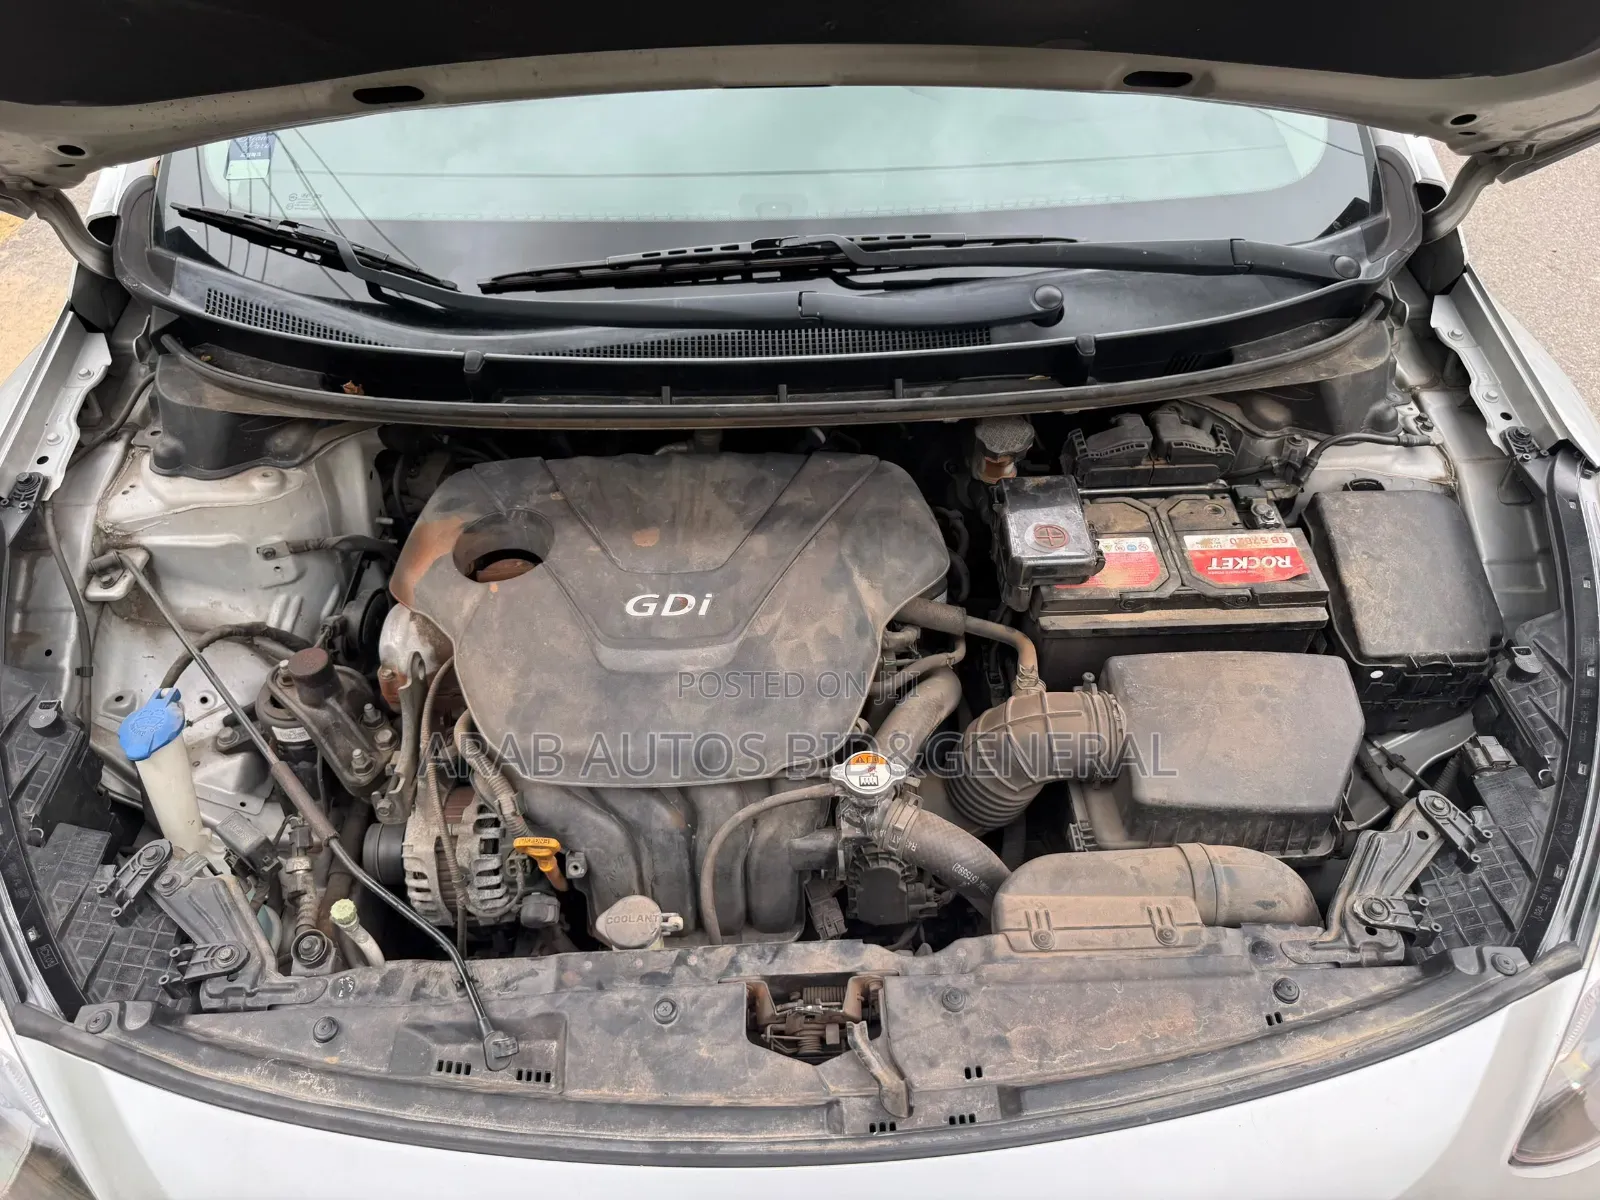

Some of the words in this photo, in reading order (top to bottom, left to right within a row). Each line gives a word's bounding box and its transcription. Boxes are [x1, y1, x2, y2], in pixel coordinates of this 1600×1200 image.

[1208, 556, 1292, 570] ROCKET
[625, 593, 713, 616] GDi
[605, 913, 660, 925] COOLANT
